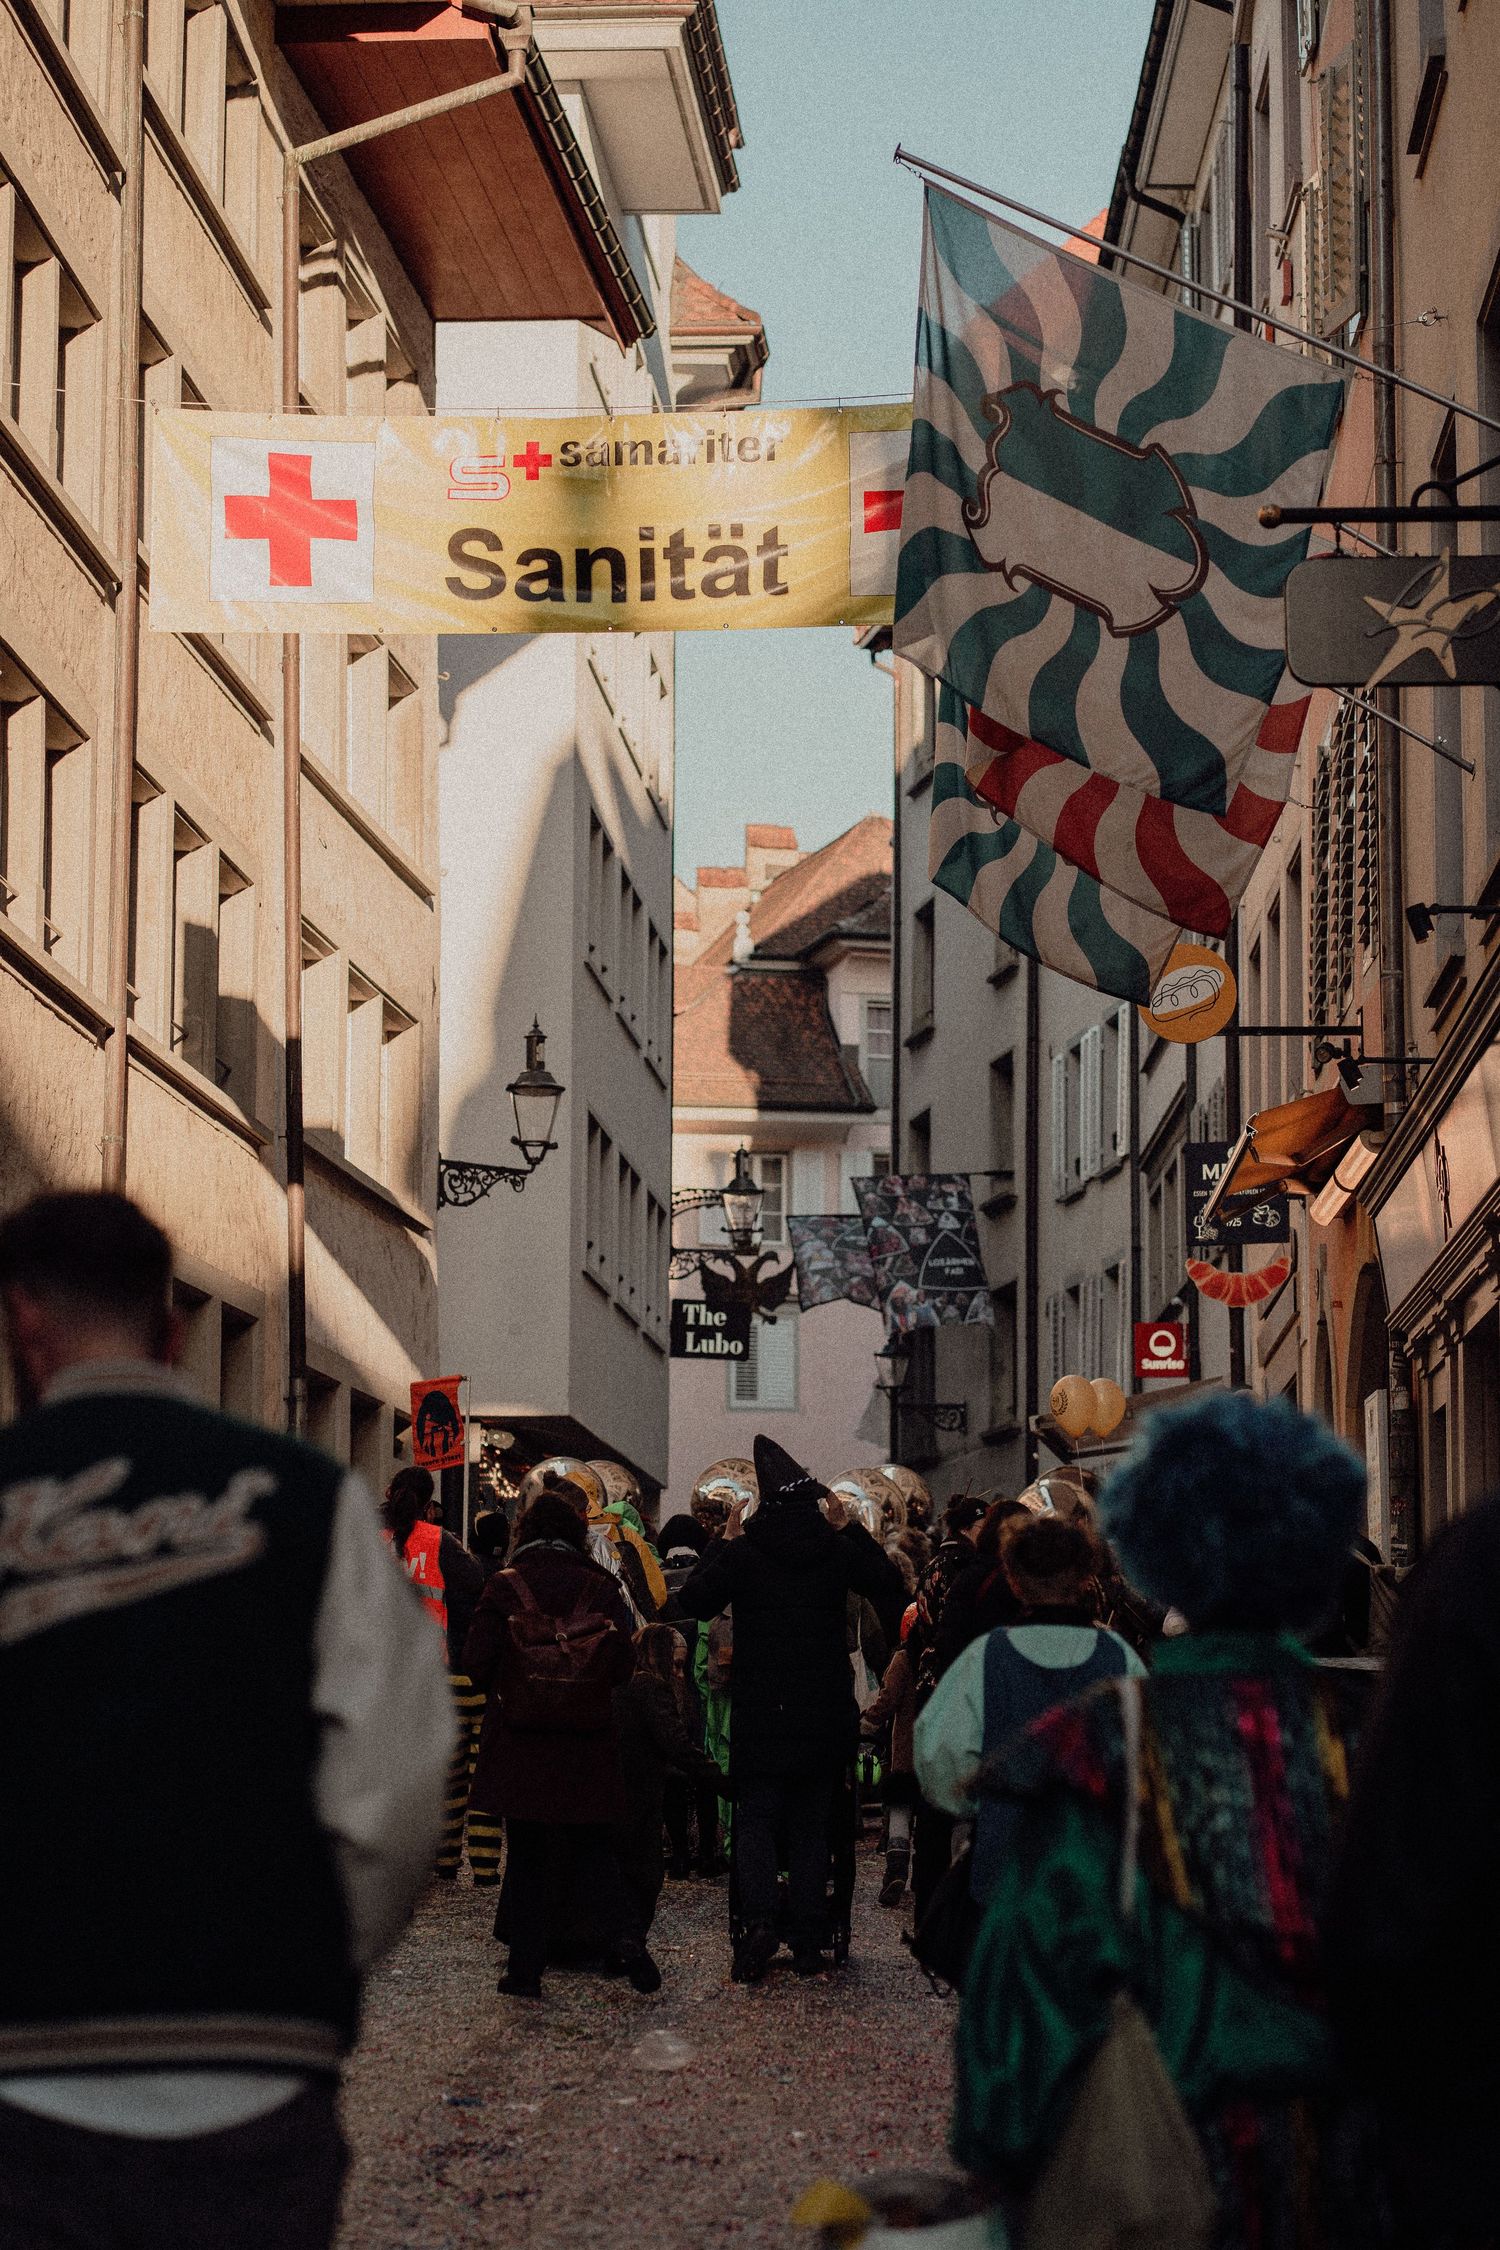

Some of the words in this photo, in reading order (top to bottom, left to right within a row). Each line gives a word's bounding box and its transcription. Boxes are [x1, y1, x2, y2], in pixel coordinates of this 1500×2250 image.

[559, 429, 784, 468] samariter
[445, 523, 790, 604] Sanität
[682, 1304, 727, 1327] The
[685, 1332, 744, 1355] Lubo
[1141, 1357, 1185, 1370] Sunrise
